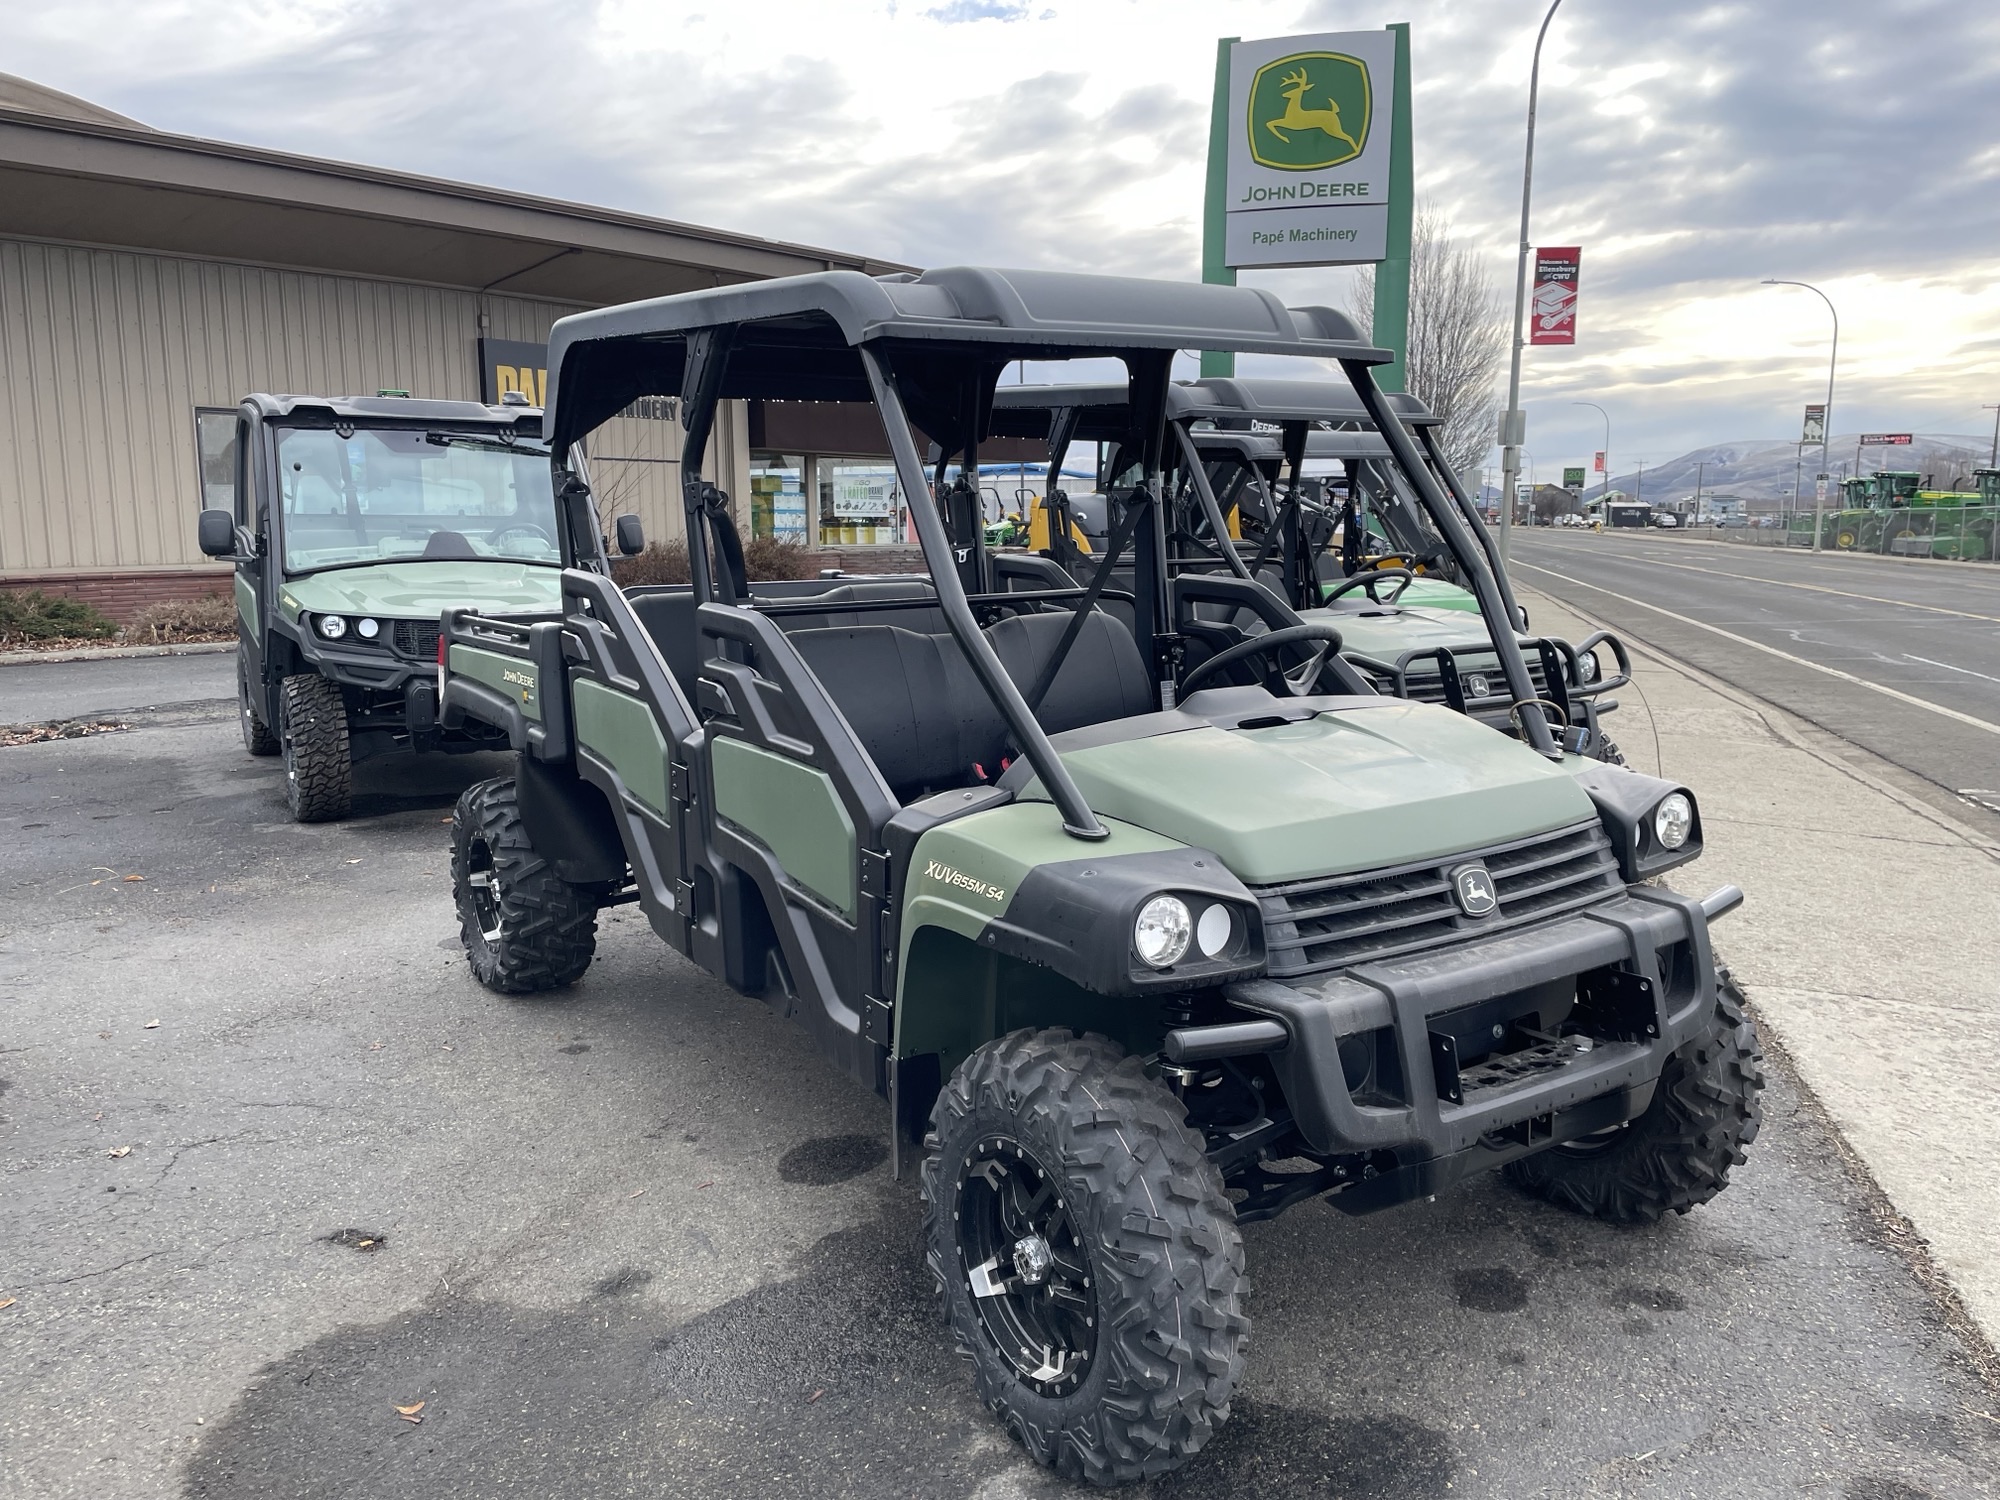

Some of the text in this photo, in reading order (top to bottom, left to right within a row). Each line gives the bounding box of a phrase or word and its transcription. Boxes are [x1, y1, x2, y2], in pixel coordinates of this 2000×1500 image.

[1242, 182, 1369, 203] JOHN DEERE
[1252, 228, 1358, 246] Papé Machinery
[868, 487, 883, 495] BRAND
[503, 668, 534, 688] JOHN DEERE
[924, 860, 1005, 902] XUV855M S4
